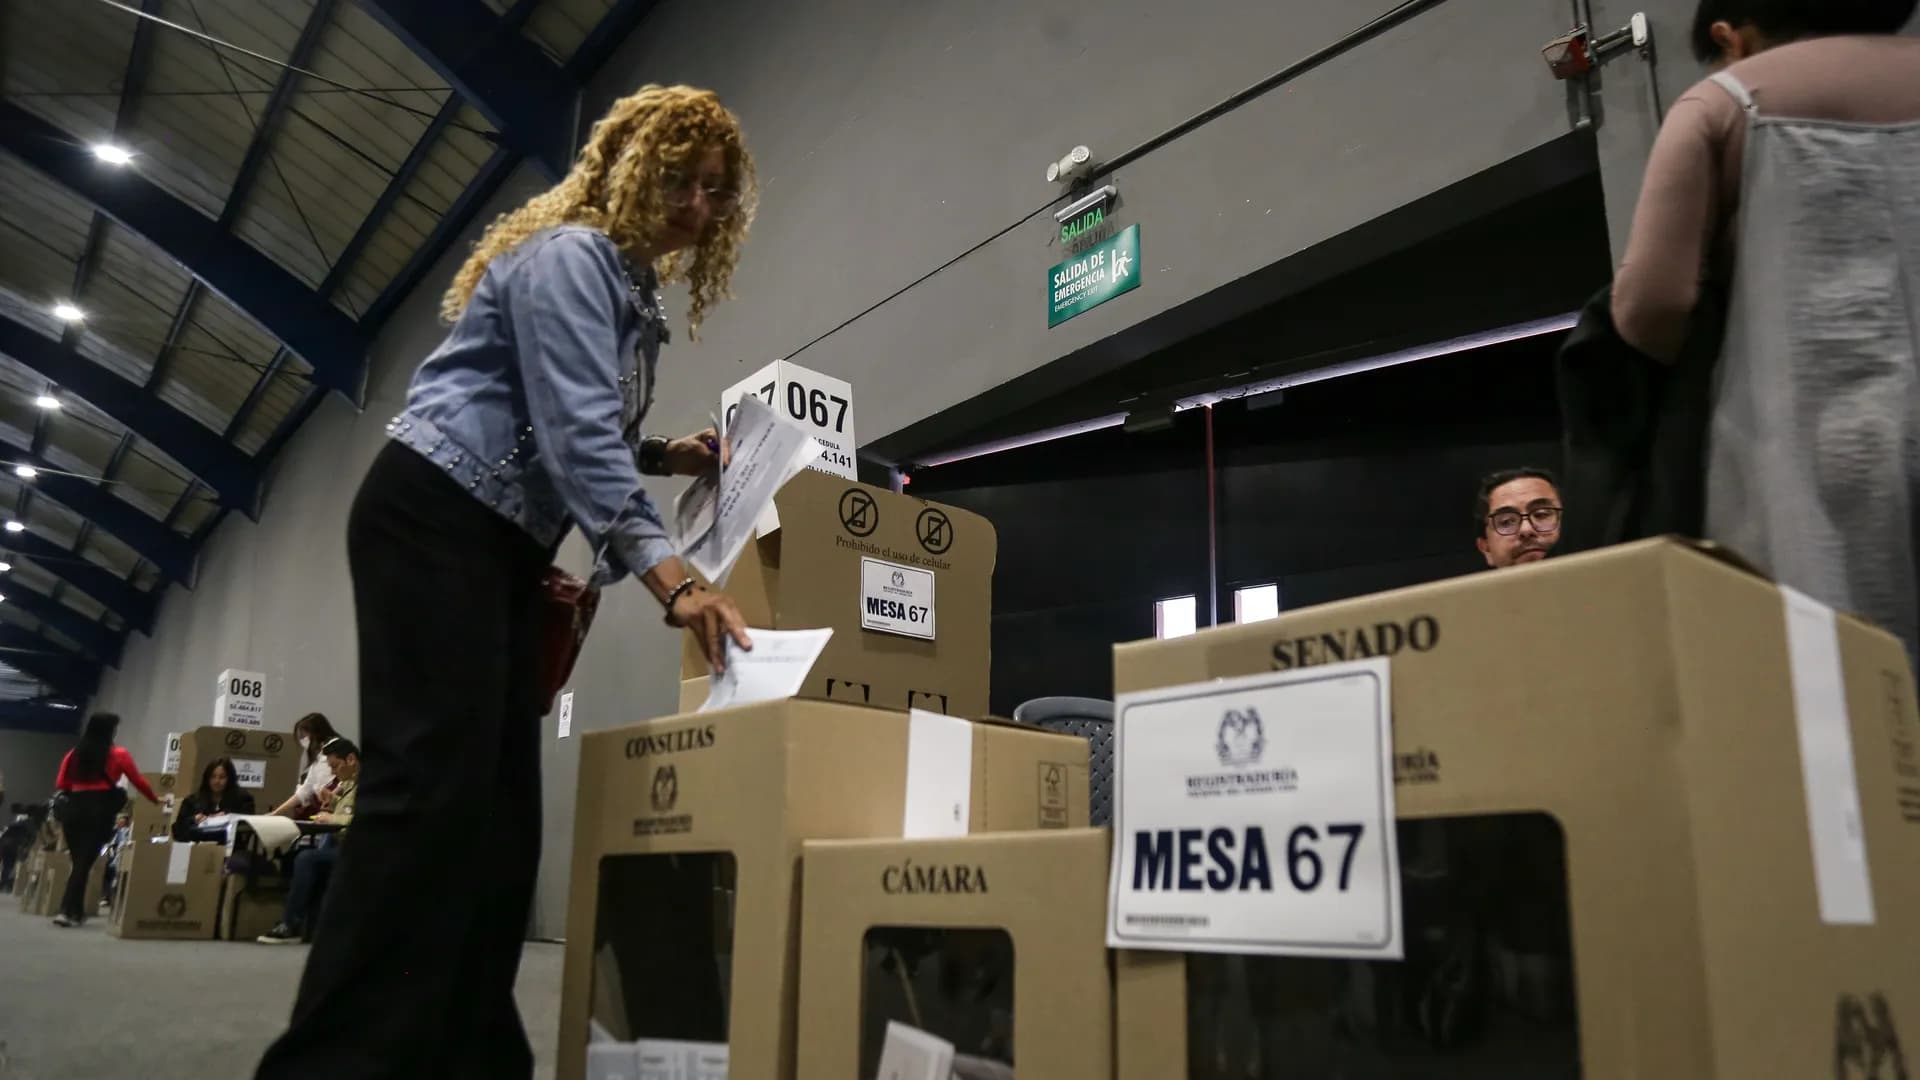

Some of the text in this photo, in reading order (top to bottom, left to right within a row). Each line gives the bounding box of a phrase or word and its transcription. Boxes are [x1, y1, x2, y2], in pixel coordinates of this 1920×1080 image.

[1061, 207, 1104, 244] SALIDA
[1054, 250, 1105, 289] SALIDA DE
[1055, 268, 1105, 302] EMERGENCIA
[1055, 285, 1099, 312] EMERGENCY EXIT
[787, 381, 848, 433] 067
[836, 535, 951, 570] Prohibido el uso de celular
[867, 596, 929, 623] MESA 67
[1272, 614, 1440, 671] SENADO
[230, 678, 262, 698] 068
[625, 724, 716, 760] CONSULTAS
[1132, 823, 1365, 893] MESA 67
[881, 858, 989, 895] CÁMARA
